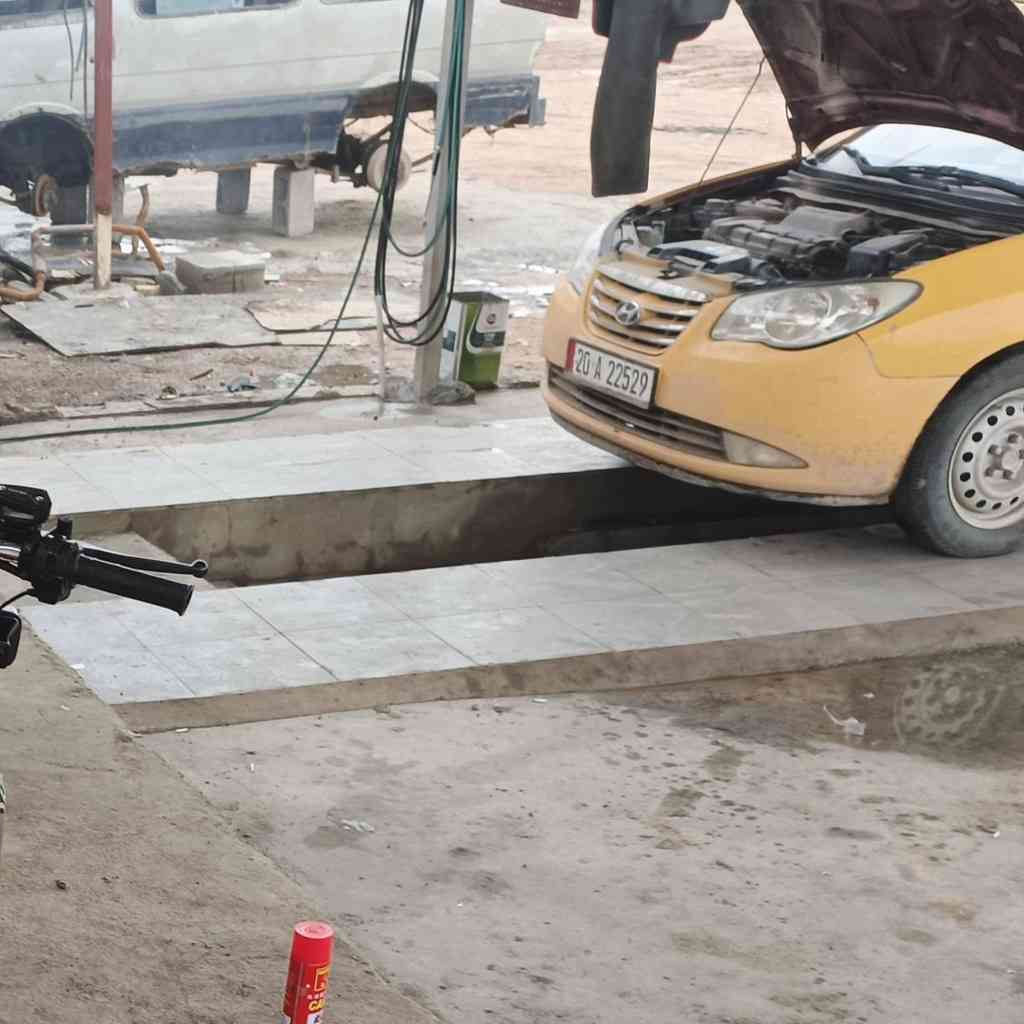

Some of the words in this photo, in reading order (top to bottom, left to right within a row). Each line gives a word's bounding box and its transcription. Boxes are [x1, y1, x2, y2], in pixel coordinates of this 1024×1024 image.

[576, 348, 590, 376] 20
[593, 354, 602, 380] A
[606, 360, 649, 397] 22529
